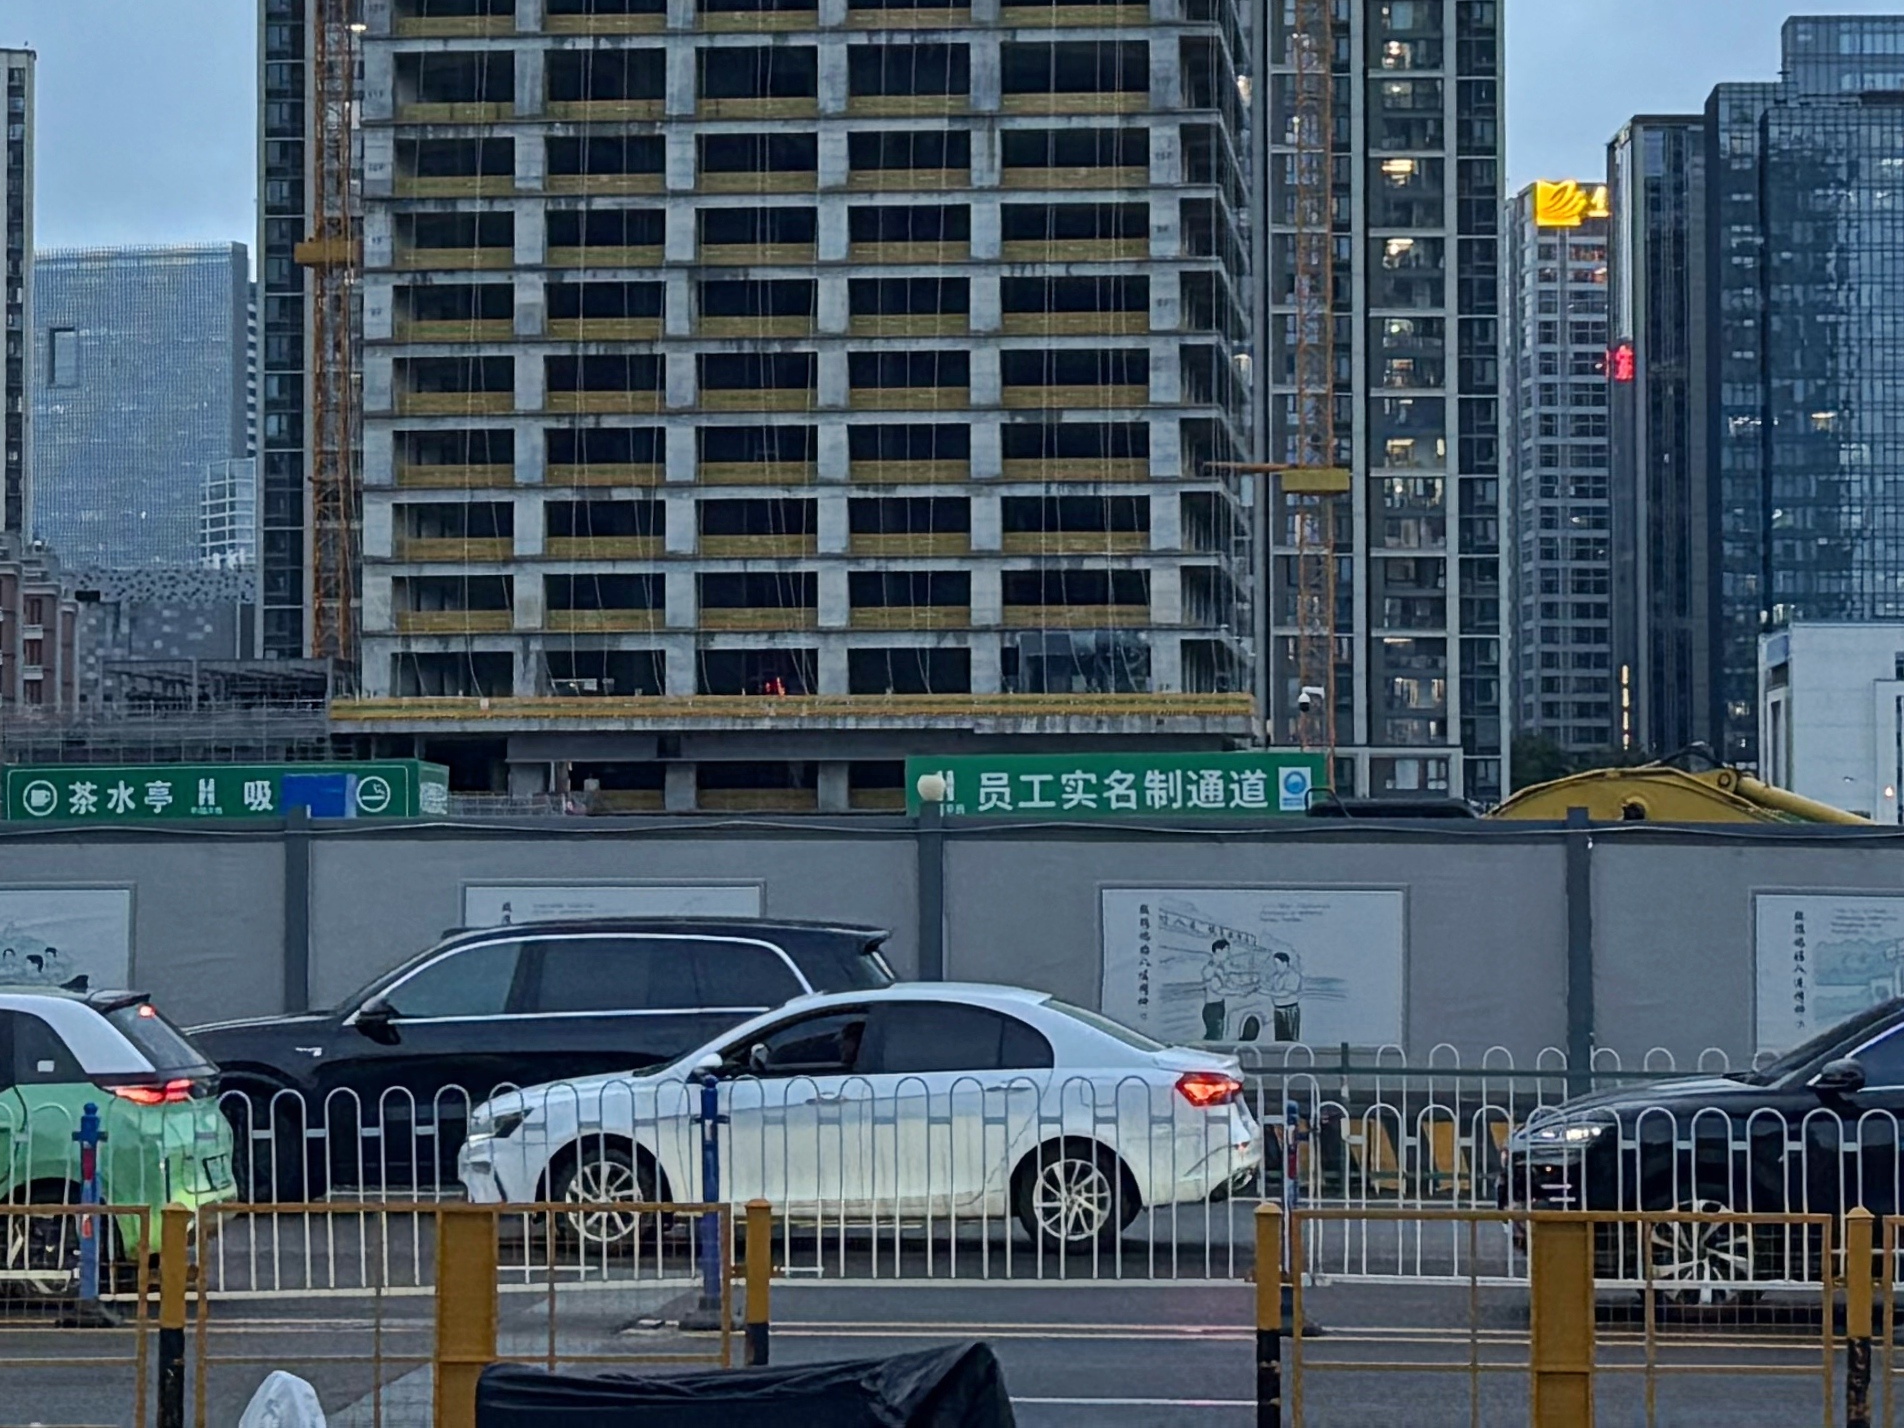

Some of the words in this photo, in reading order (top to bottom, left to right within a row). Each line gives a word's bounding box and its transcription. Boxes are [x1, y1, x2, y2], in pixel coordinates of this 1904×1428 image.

[68, 780, 173, 814] 茶水亭
[977, 768, 1269, 812] 员工实名制通道
